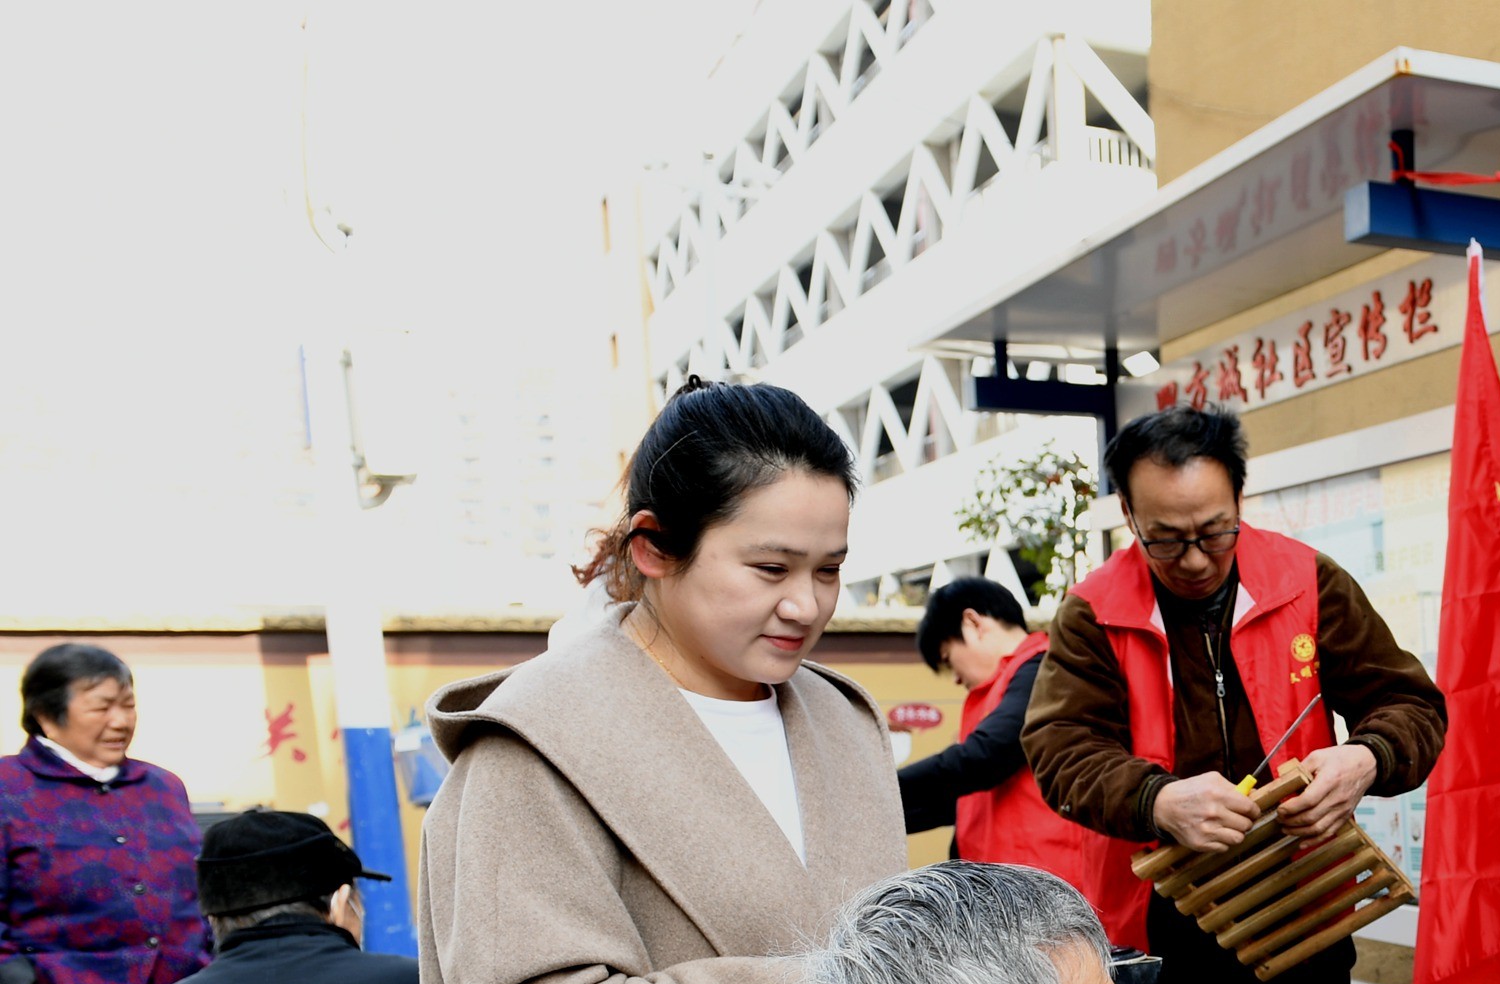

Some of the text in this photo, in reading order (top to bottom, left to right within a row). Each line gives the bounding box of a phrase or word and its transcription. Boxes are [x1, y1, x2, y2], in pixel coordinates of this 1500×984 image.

[1156, 278, 1438, 411] 四方城社区宣传栏
